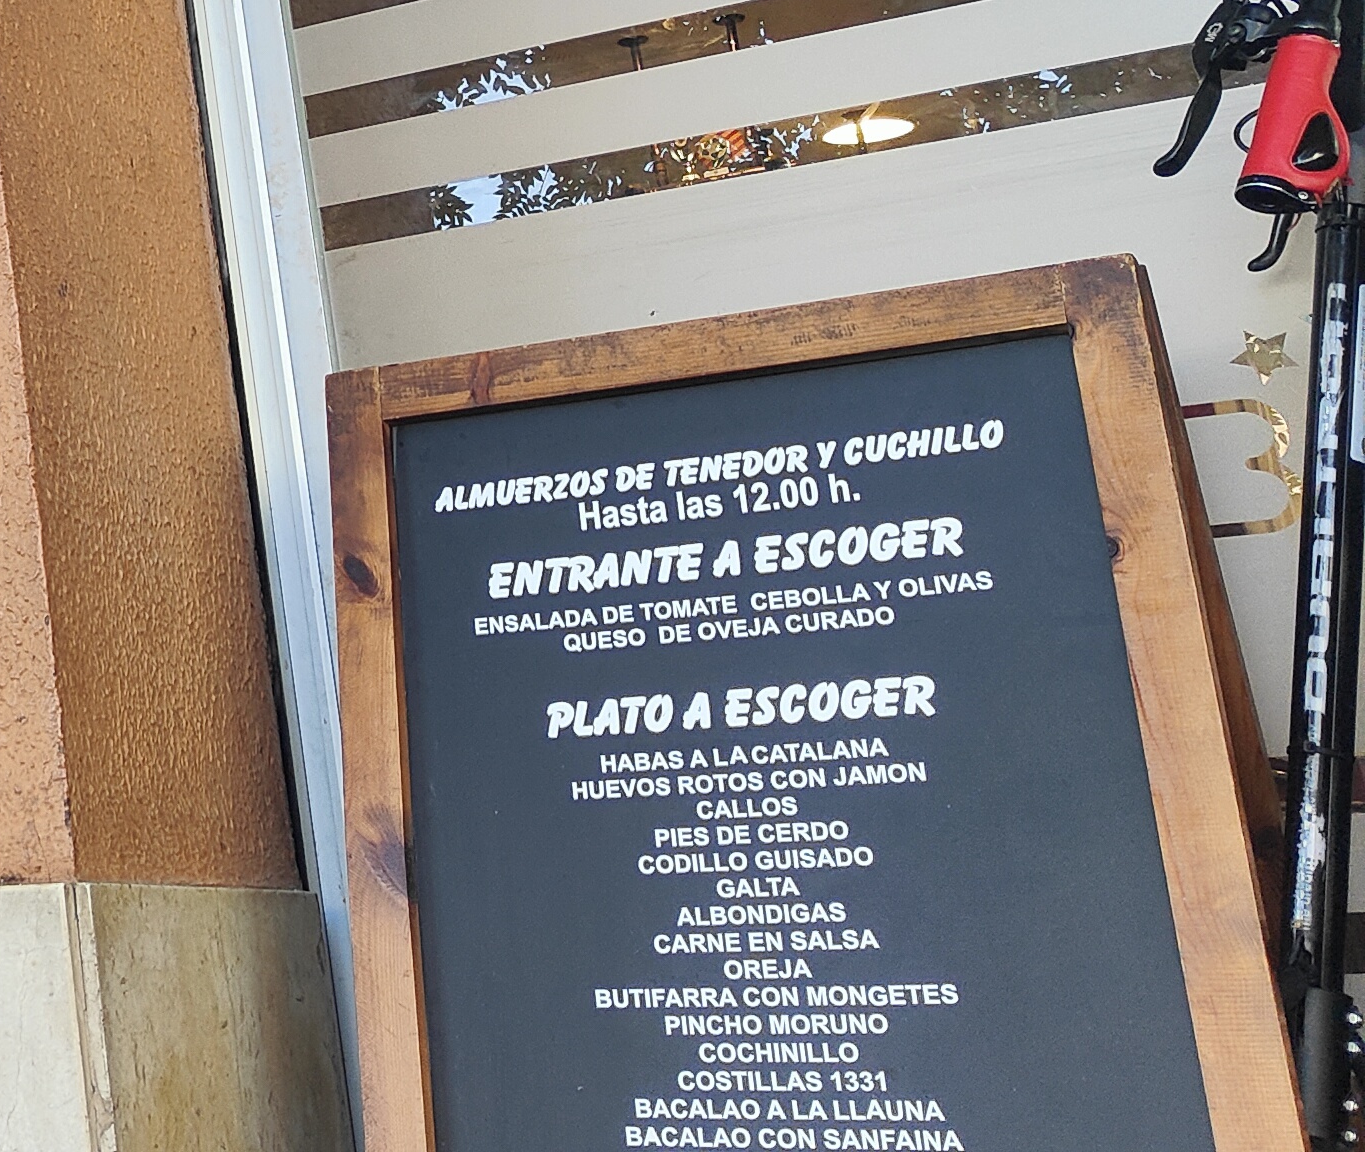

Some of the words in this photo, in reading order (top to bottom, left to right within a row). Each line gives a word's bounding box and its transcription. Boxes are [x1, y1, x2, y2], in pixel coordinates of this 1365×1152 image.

[434, 467, 609, 513] ALMUERZOS
[615, 462, 656, 493] DE
[663, 444, 809, 487] TENEDOR
[816, 440, 837, 469] Y
[843, 419, 1004, 466] CUCHILLO
[578, 496, 668, 531] Hasta
[675, 490, 724, 521] las
[732, 476, 819, 514] 12.00
[827, 473, 861, 504] h.
[488, 542, 704, 599] ENTRANTE
[712, 539, 741, 578] A
[753, 516, 964, 574] ESCOGER
[474, 608, 599, 636] ENSALADA
[601, 604, 635, 625] DE
[638, 594, 738, 621] TOMATE
[750, 582, 872, 611] CEBOLLA
[873, 580, 892, 600] Y
[898, 570, 994, 598] OLIVAS
[546, 693, 674, 739] PLATO
[682, 691, 712, 730] A
[724, 675, 936, 728] ESCOGER
[637, 851, 748, 875] CODILLO
[754, 846, 874, 871] GUISADO
[676, 901, 847, 927] ALBONDIGAS
[594, 987, 739, 1009] BUTIFARRA
[742, 986, 800, 1008] CON
[805, 982, 959, 1007] MONGETES
[698, 1042, 860, 1064] COCHINILLO
[677, 1070, 823, 1092] COSTILLAS
[829, 1070, 887, 1092] 1331
